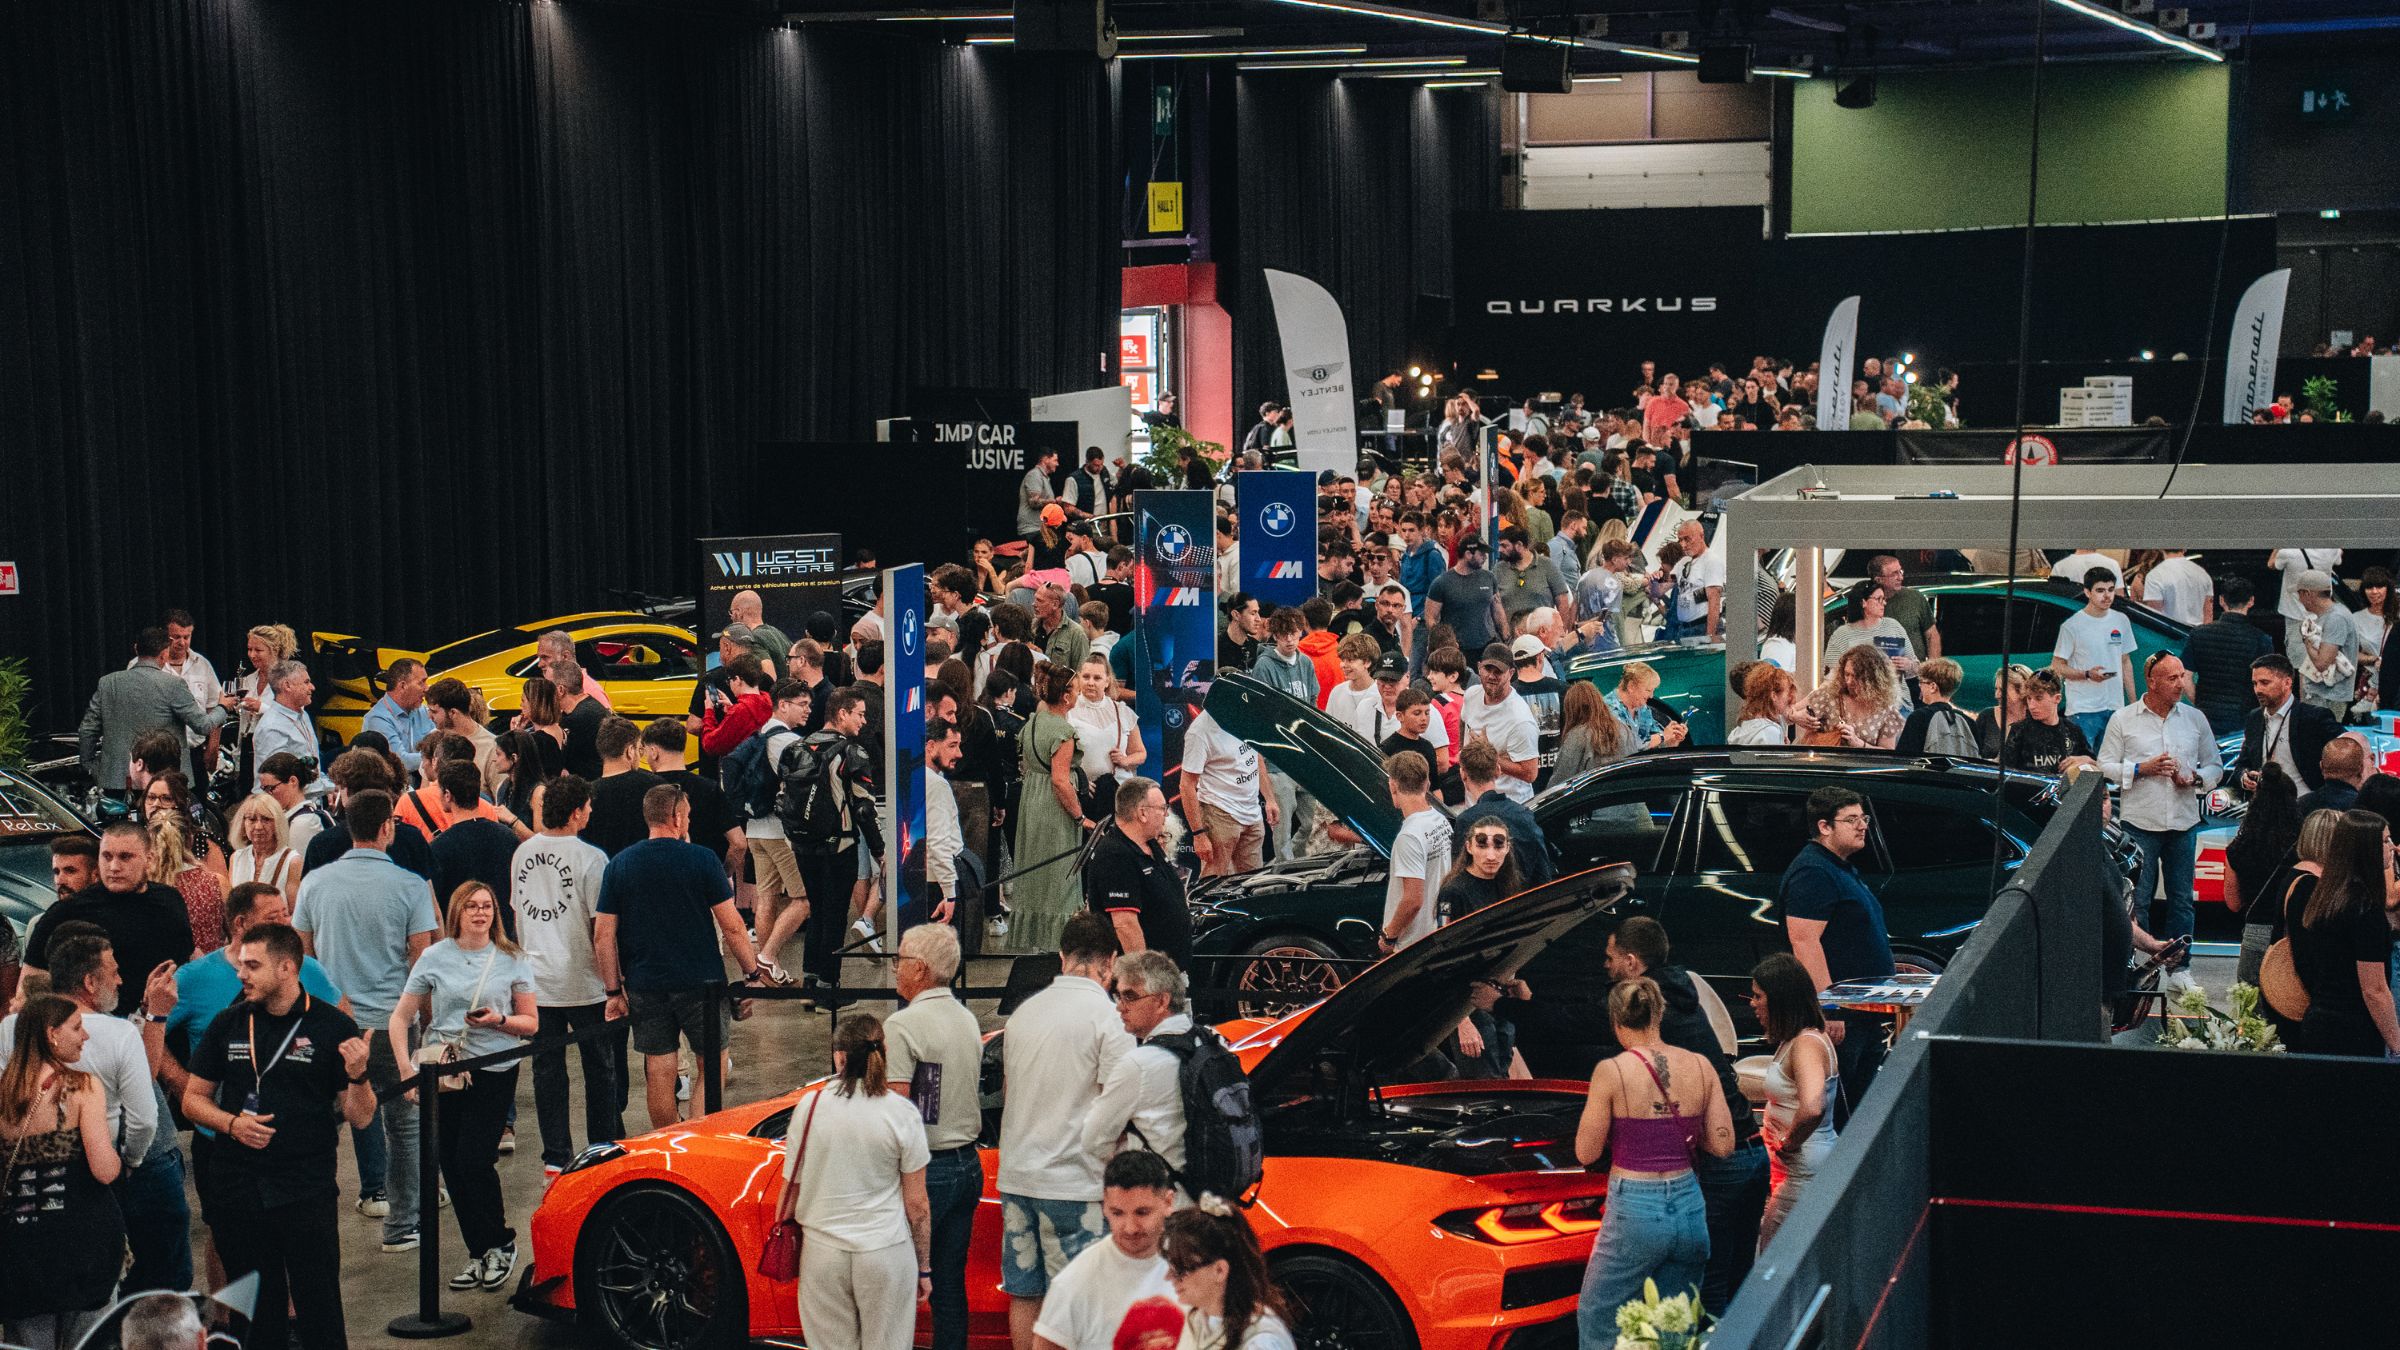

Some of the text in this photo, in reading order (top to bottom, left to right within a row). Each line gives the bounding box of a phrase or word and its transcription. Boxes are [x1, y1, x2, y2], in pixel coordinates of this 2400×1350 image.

[1487, 297, 1717, 314] QUARKUS
[978, 424, 1016, 445] CAR
[756, 548, 834, 565] WEST
[757, 564, 835, 576] MOTORS
[2034, 754, 2062, 767] HAV
[2212, 794, 2223, 807] E
[1, 818, 63, 831] Relax
[518, 853, 574, 888] MONCLER
[522, 900, 568, 922] FRGMT
